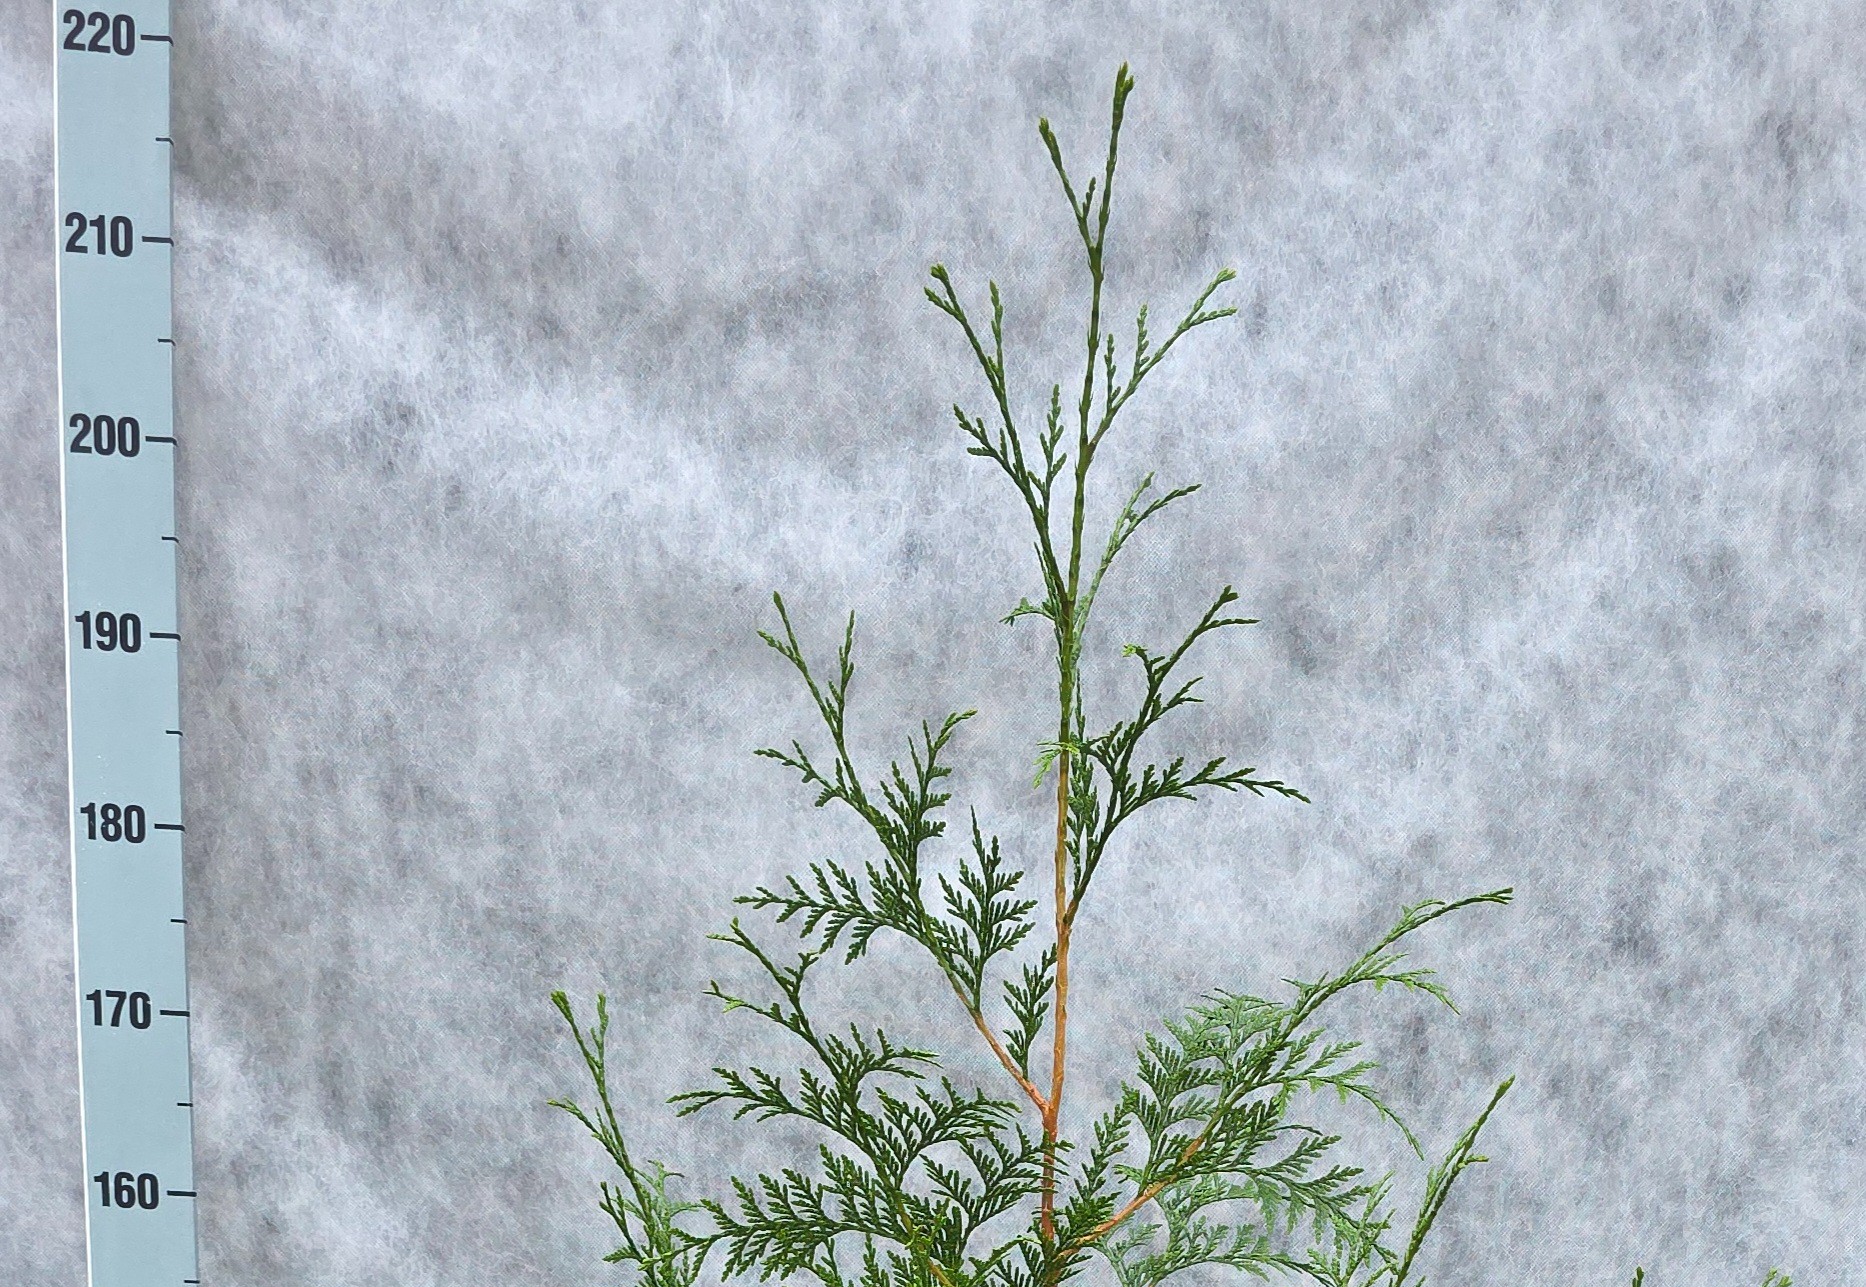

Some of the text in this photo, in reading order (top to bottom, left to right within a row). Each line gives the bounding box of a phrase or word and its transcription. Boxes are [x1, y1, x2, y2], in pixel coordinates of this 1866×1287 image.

[63, 9, 135, 56] 220
[65, 211, 133, 258] 210
[69, 413, 140, 458] 200
[74, 610, 141, 653] 190
[80, 802, 146, 844] 180
[86, 989, 151, 1030] 170
[93, 1171, 159, 1210] 160
